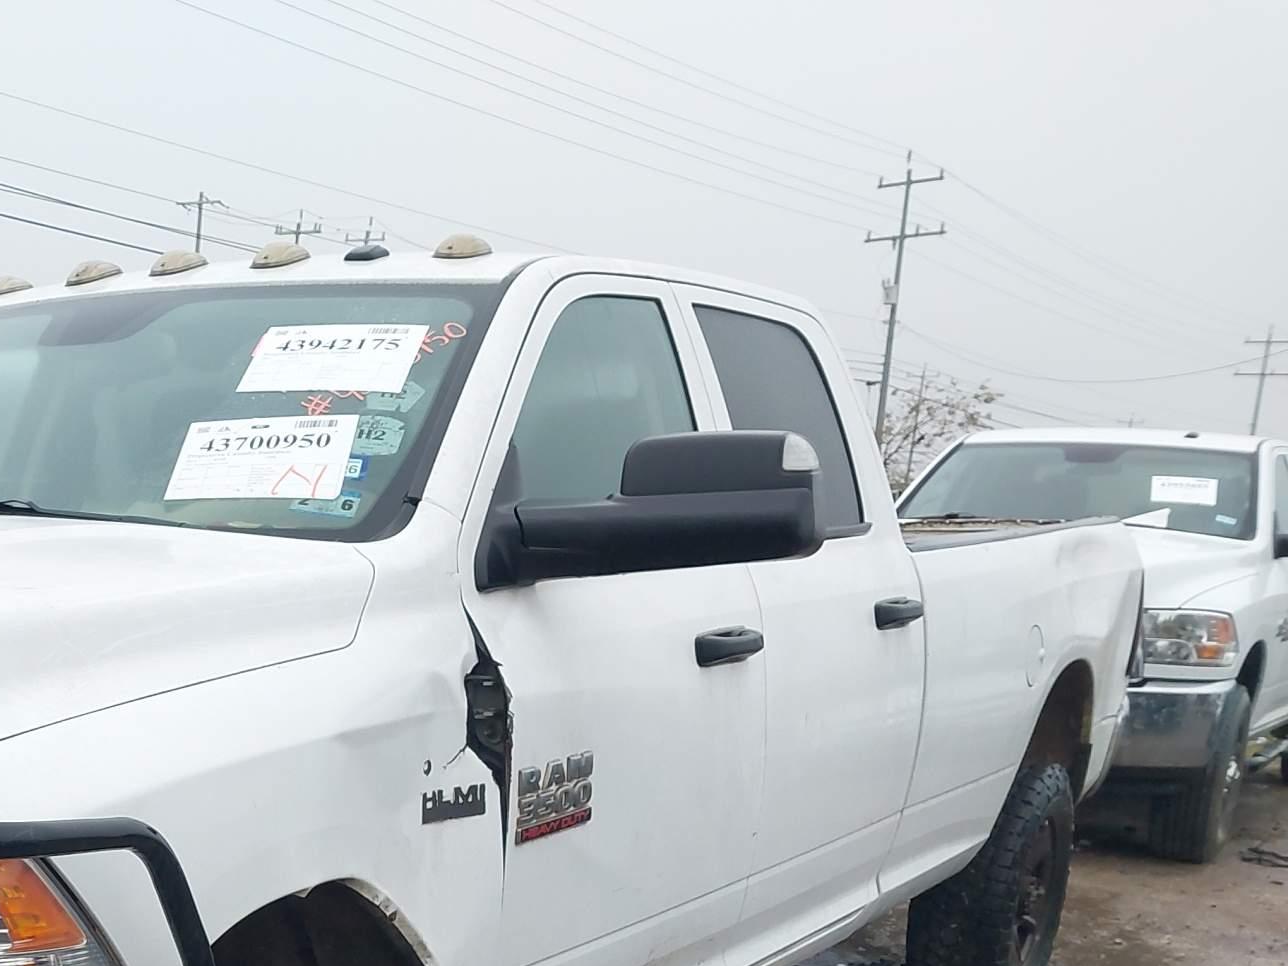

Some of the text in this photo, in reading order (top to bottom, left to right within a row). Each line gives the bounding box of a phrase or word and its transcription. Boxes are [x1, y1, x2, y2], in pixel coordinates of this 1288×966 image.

[275, 338, 402, 352] 43942175
[200, 432, 332, 452] 43700950
[518, 750, 593, 797] RAM
[521, 809, 591, 842] HEAVY DUTY
